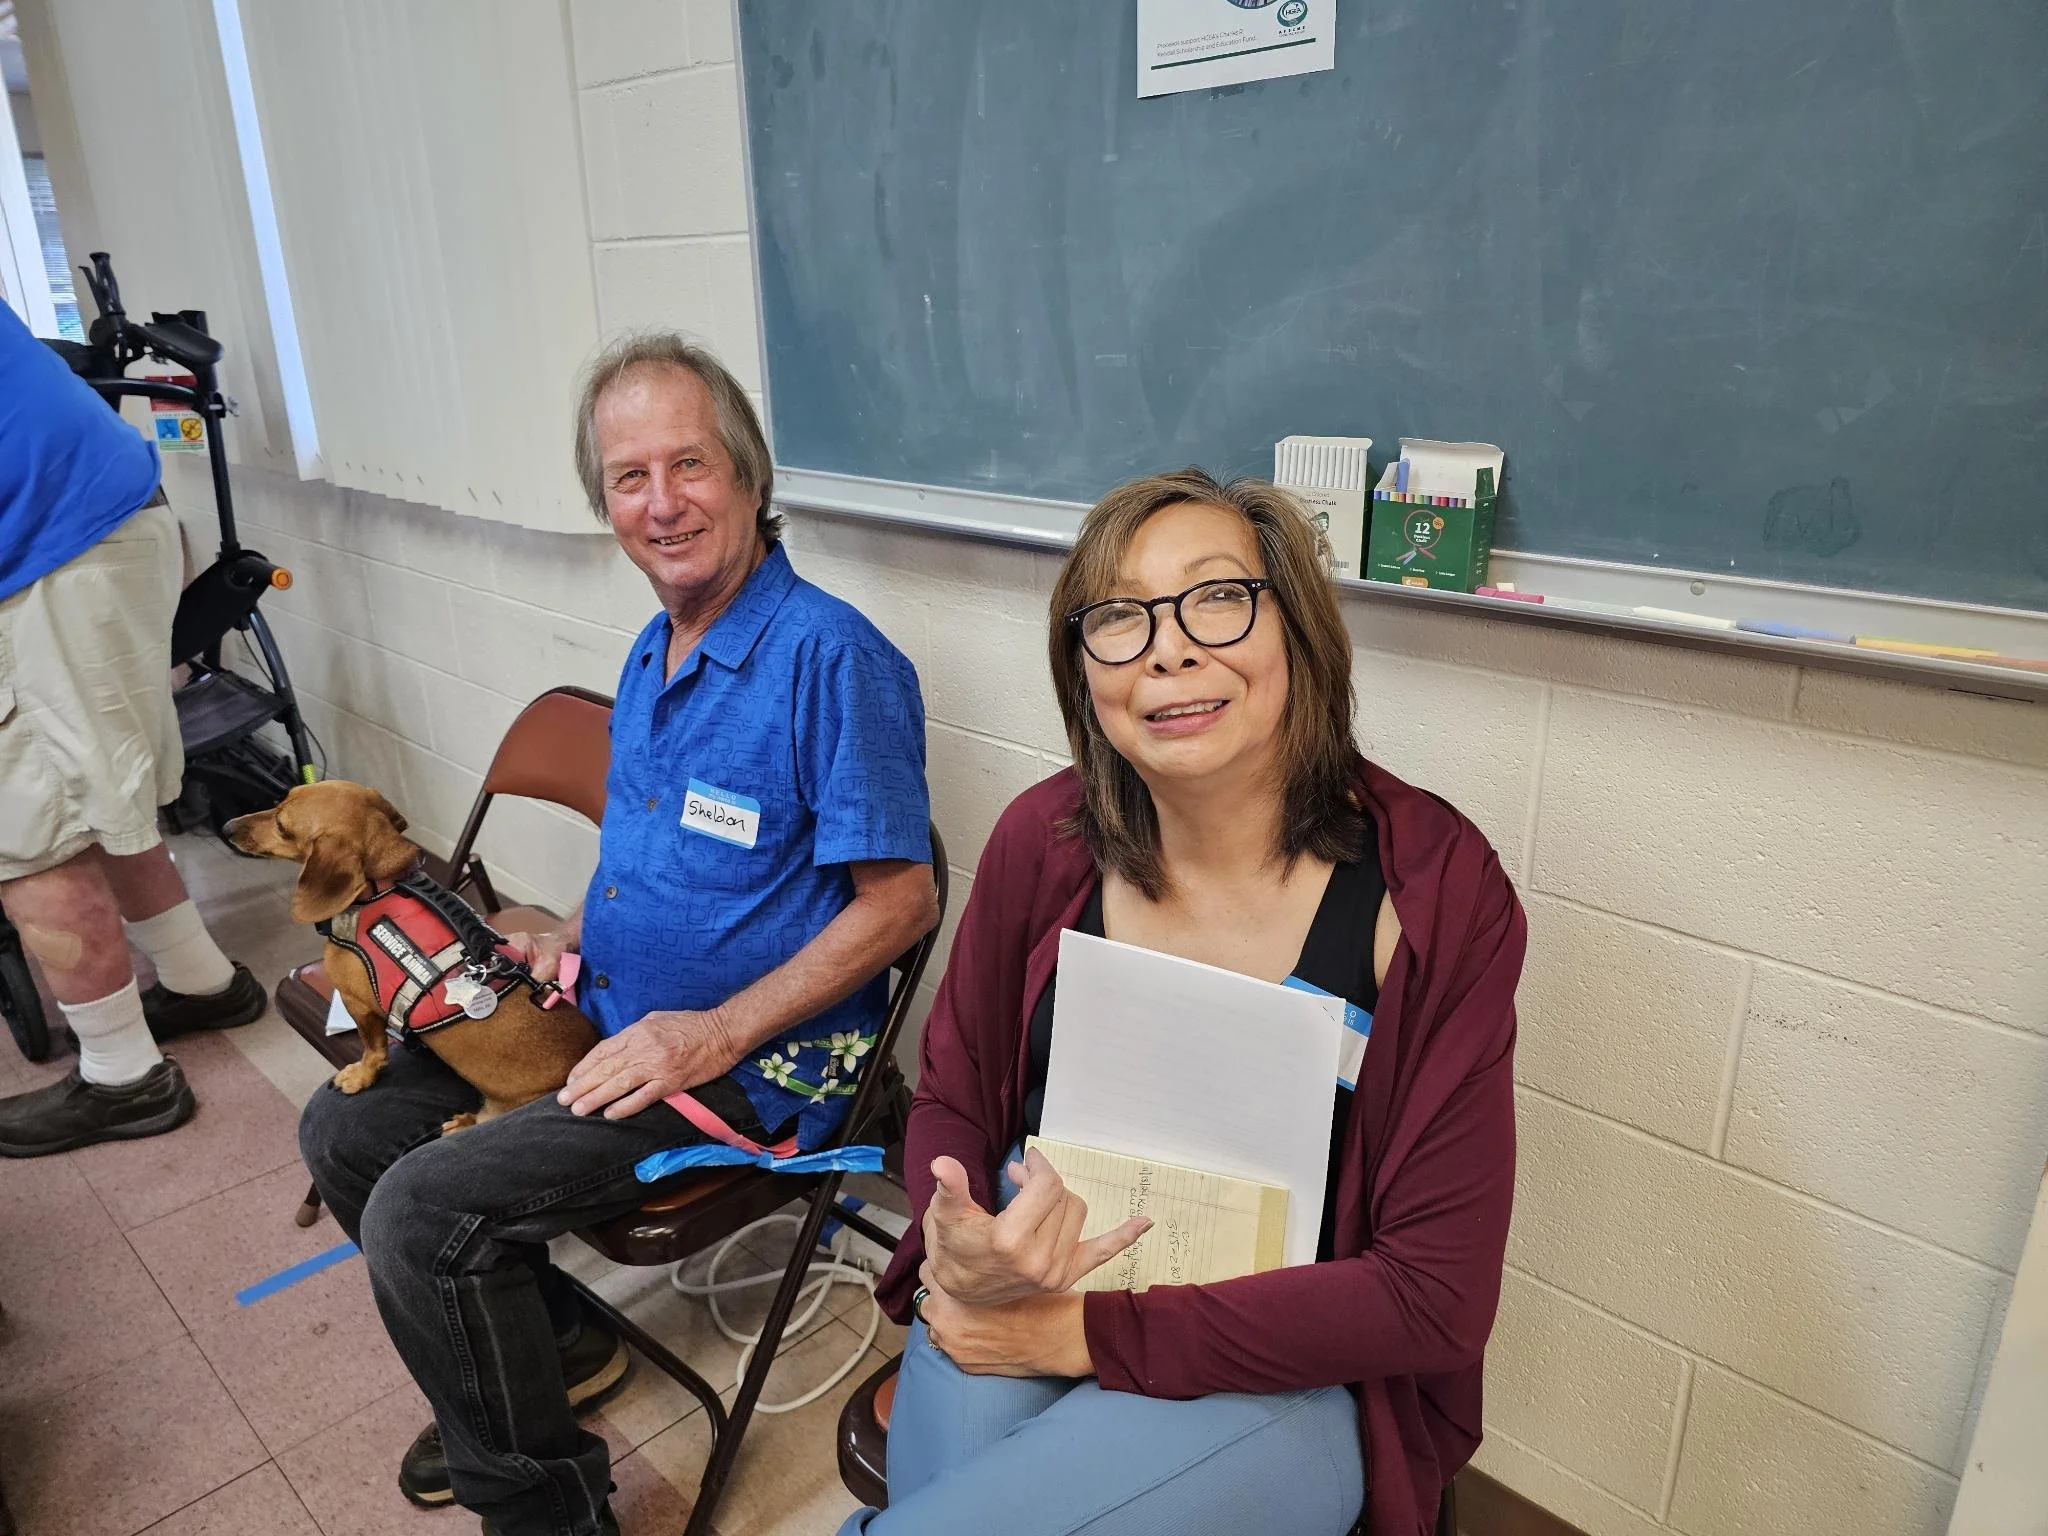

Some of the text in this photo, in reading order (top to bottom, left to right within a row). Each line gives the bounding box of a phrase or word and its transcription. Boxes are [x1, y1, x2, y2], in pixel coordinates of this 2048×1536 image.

[1286, 8, 1302, 16] HGEA
[1176, 44, 1204, 55] Scholarship
[1216, 38, 1242, 48] Education
[1180, 36, 1200, 46] support
[1414, 522, 1430, 534] 12
[710, 788, 737, 801] HELLO
[689, 800, 746, 832] Sheldon
[372, 924, 432, 986] SERVICE ANIMAL
